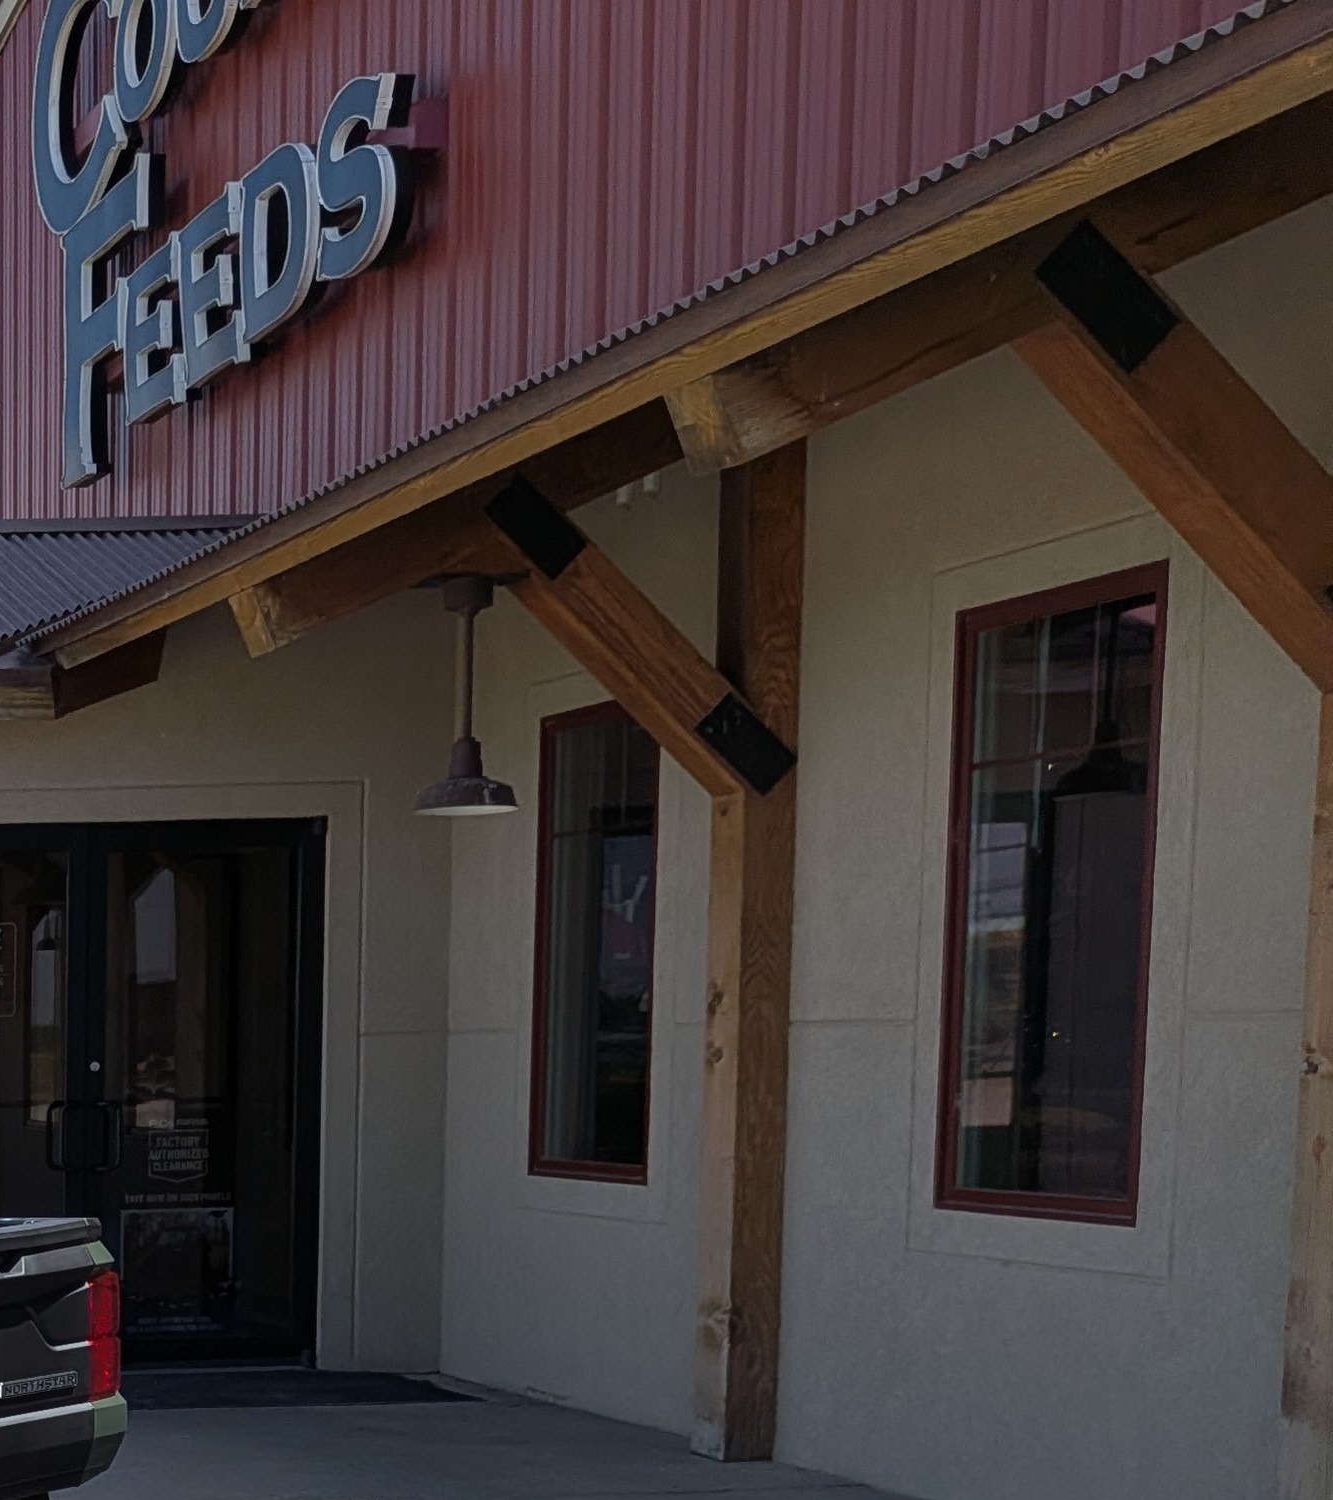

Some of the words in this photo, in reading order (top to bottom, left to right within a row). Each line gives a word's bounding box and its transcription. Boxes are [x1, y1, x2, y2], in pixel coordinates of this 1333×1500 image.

[61, 72, 396, 489] FEEDS
[155, 1136, 201, 1148] FACTORY
[148, 1147, 209, 1160] AUTHORIZED
[152, 1160, 204, 1171] CLEARANCE
[4, 1375, 76, 1396] NORTHSTAR
